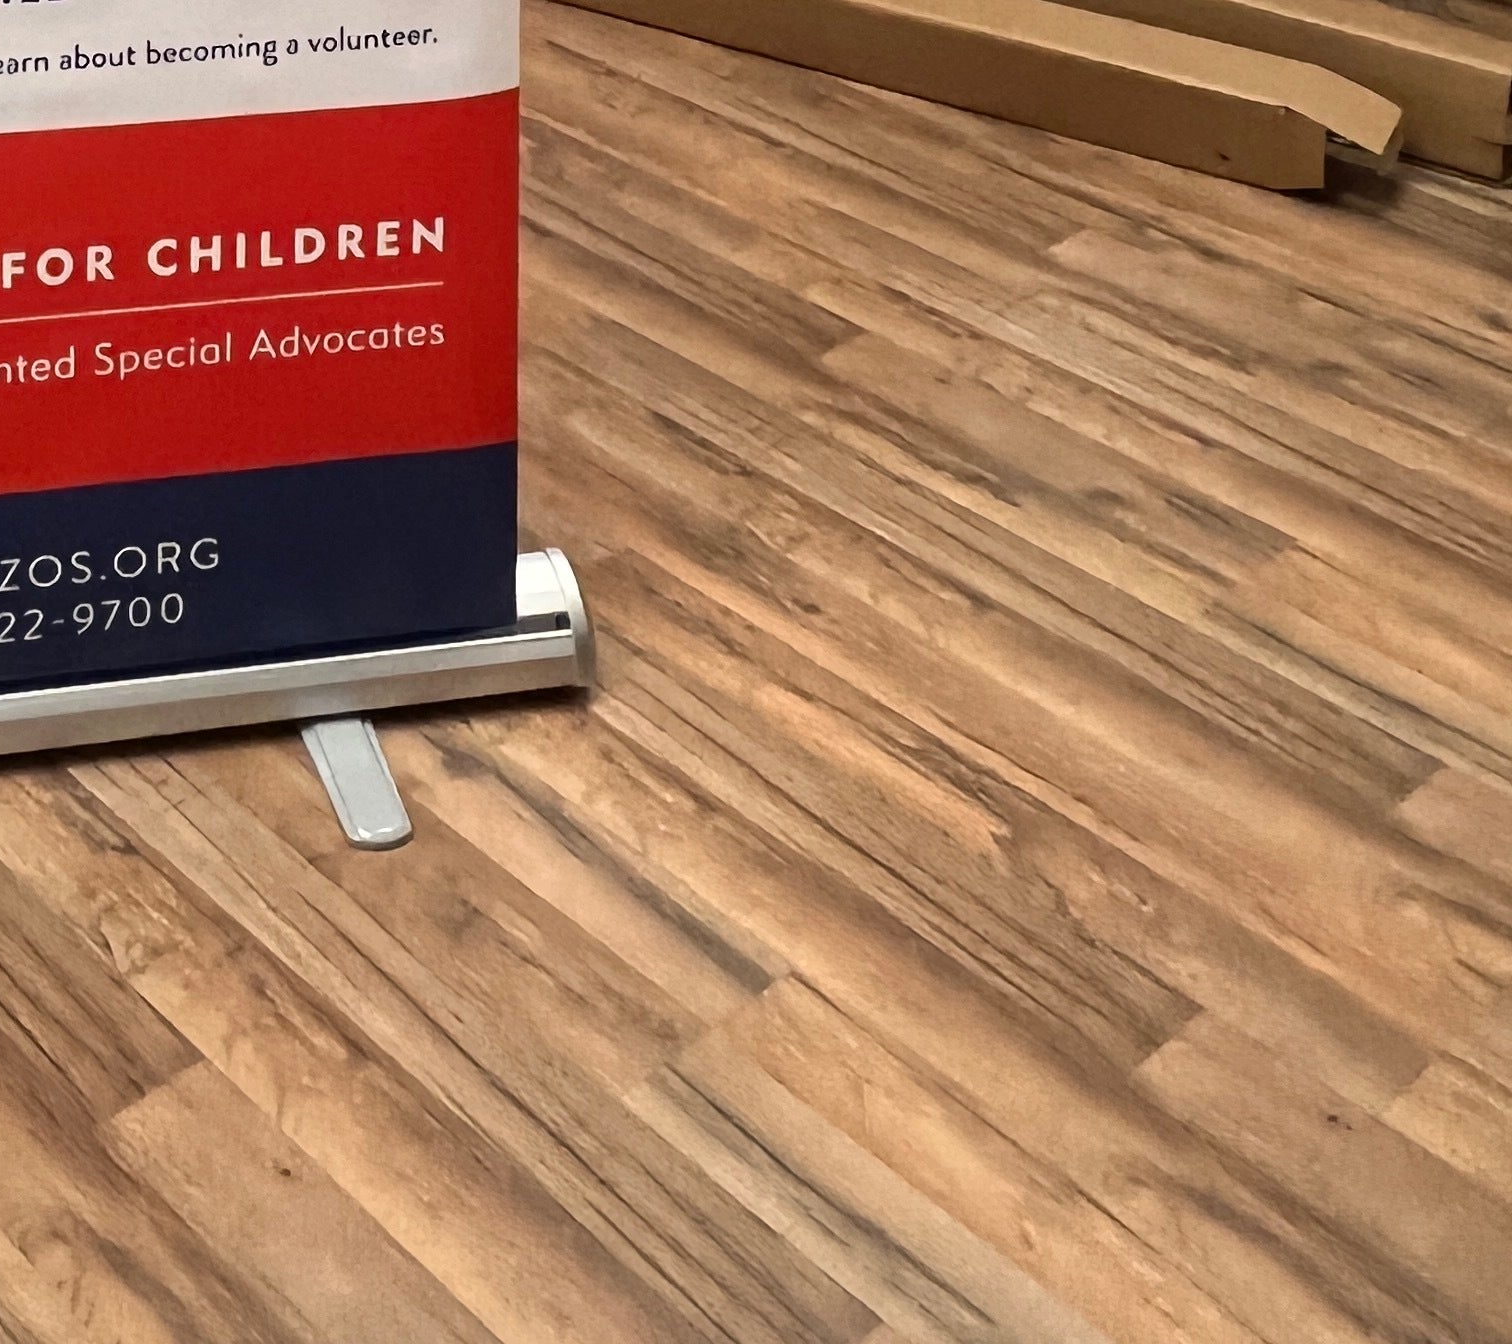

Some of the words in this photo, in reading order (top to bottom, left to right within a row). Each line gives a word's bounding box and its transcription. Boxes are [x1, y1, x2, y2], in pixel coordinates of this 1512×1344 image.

[60, 44, 136, 71] about
[147, 36, 277, 68] becoming
[287, 39, 298, 55] a
[308, 26, 438, 53] volunteer.
[3, 246, 114, 288] FOR
[148, 217, 443, 276] CHILDREN
[95, 332, 231, 381] Special
[249, 322, 444, 361] Advocates
